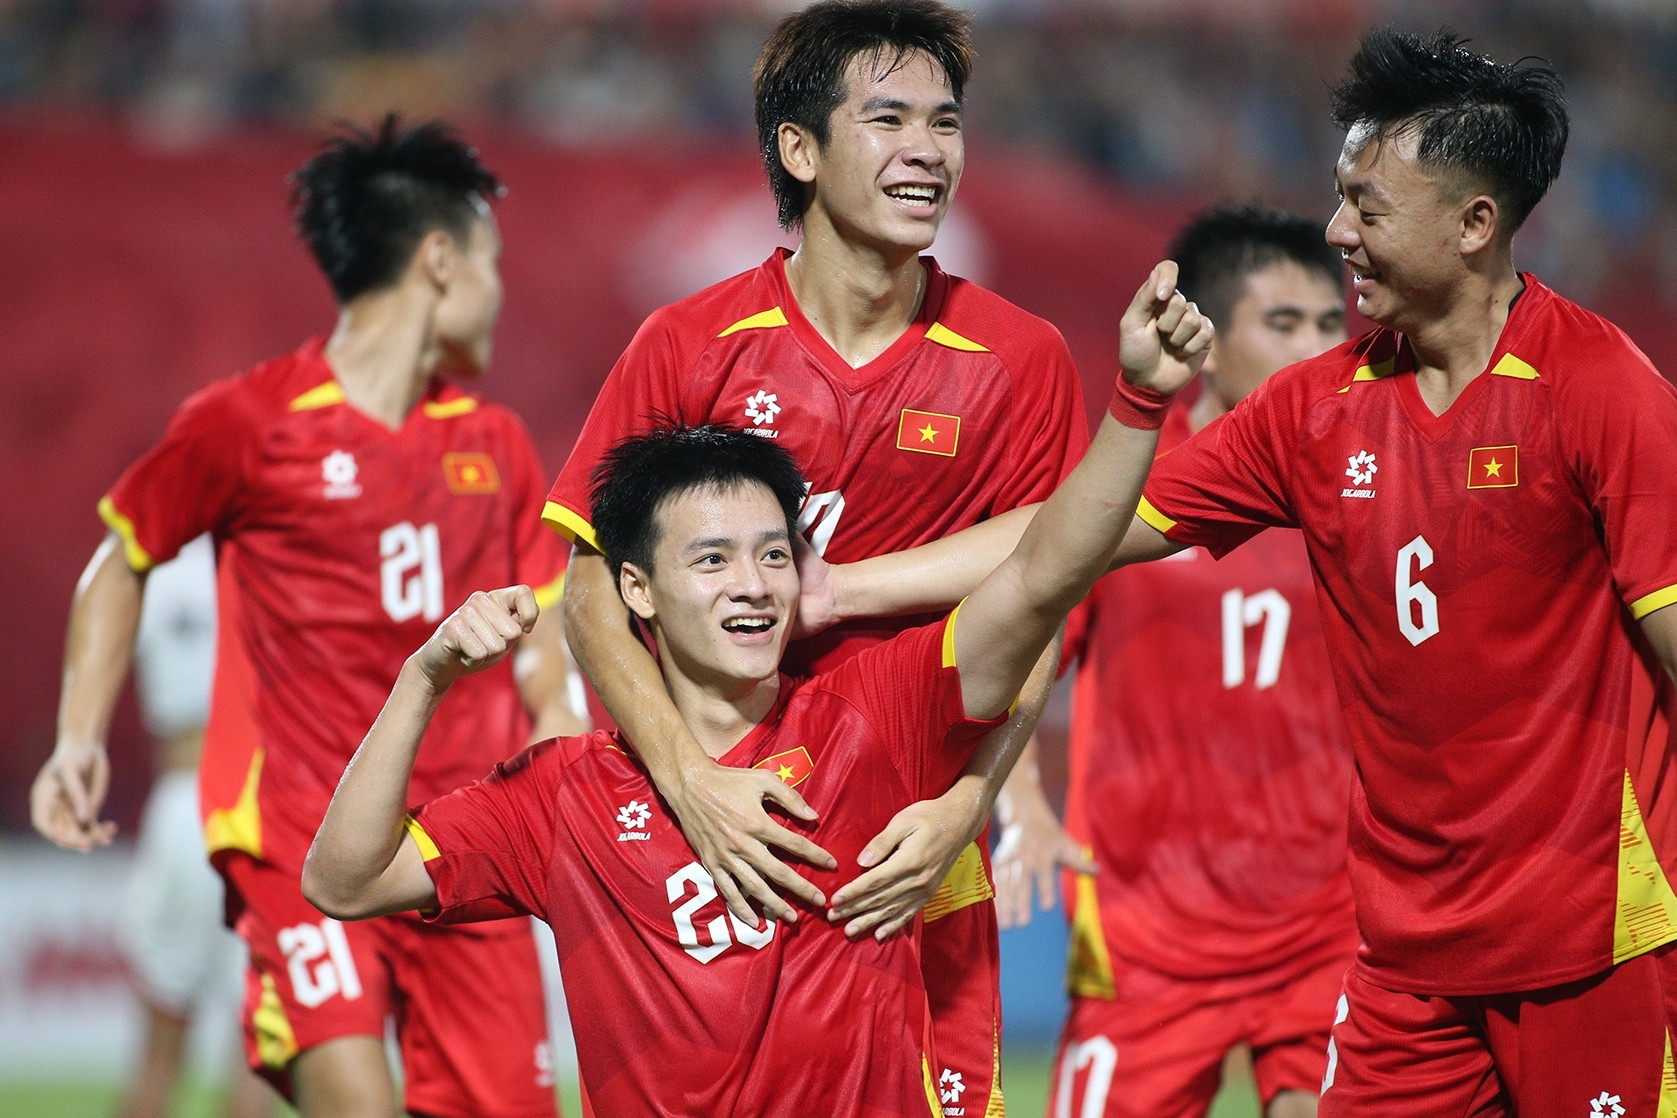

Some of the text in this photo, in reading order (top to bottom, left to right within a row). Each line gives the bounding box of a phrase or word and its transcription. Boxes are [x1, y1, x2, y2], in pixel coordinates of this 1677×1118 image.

[1340, 488, 1377, 499] JOGARBOLA
[379, 521, 445, 624] 21
[1395, 534, 1440, 647] 6
[1222, 587, 1292, 691] 17
[276, 915, 363, 1009] 21
[1055, 1034, 1119, 1118] 17
